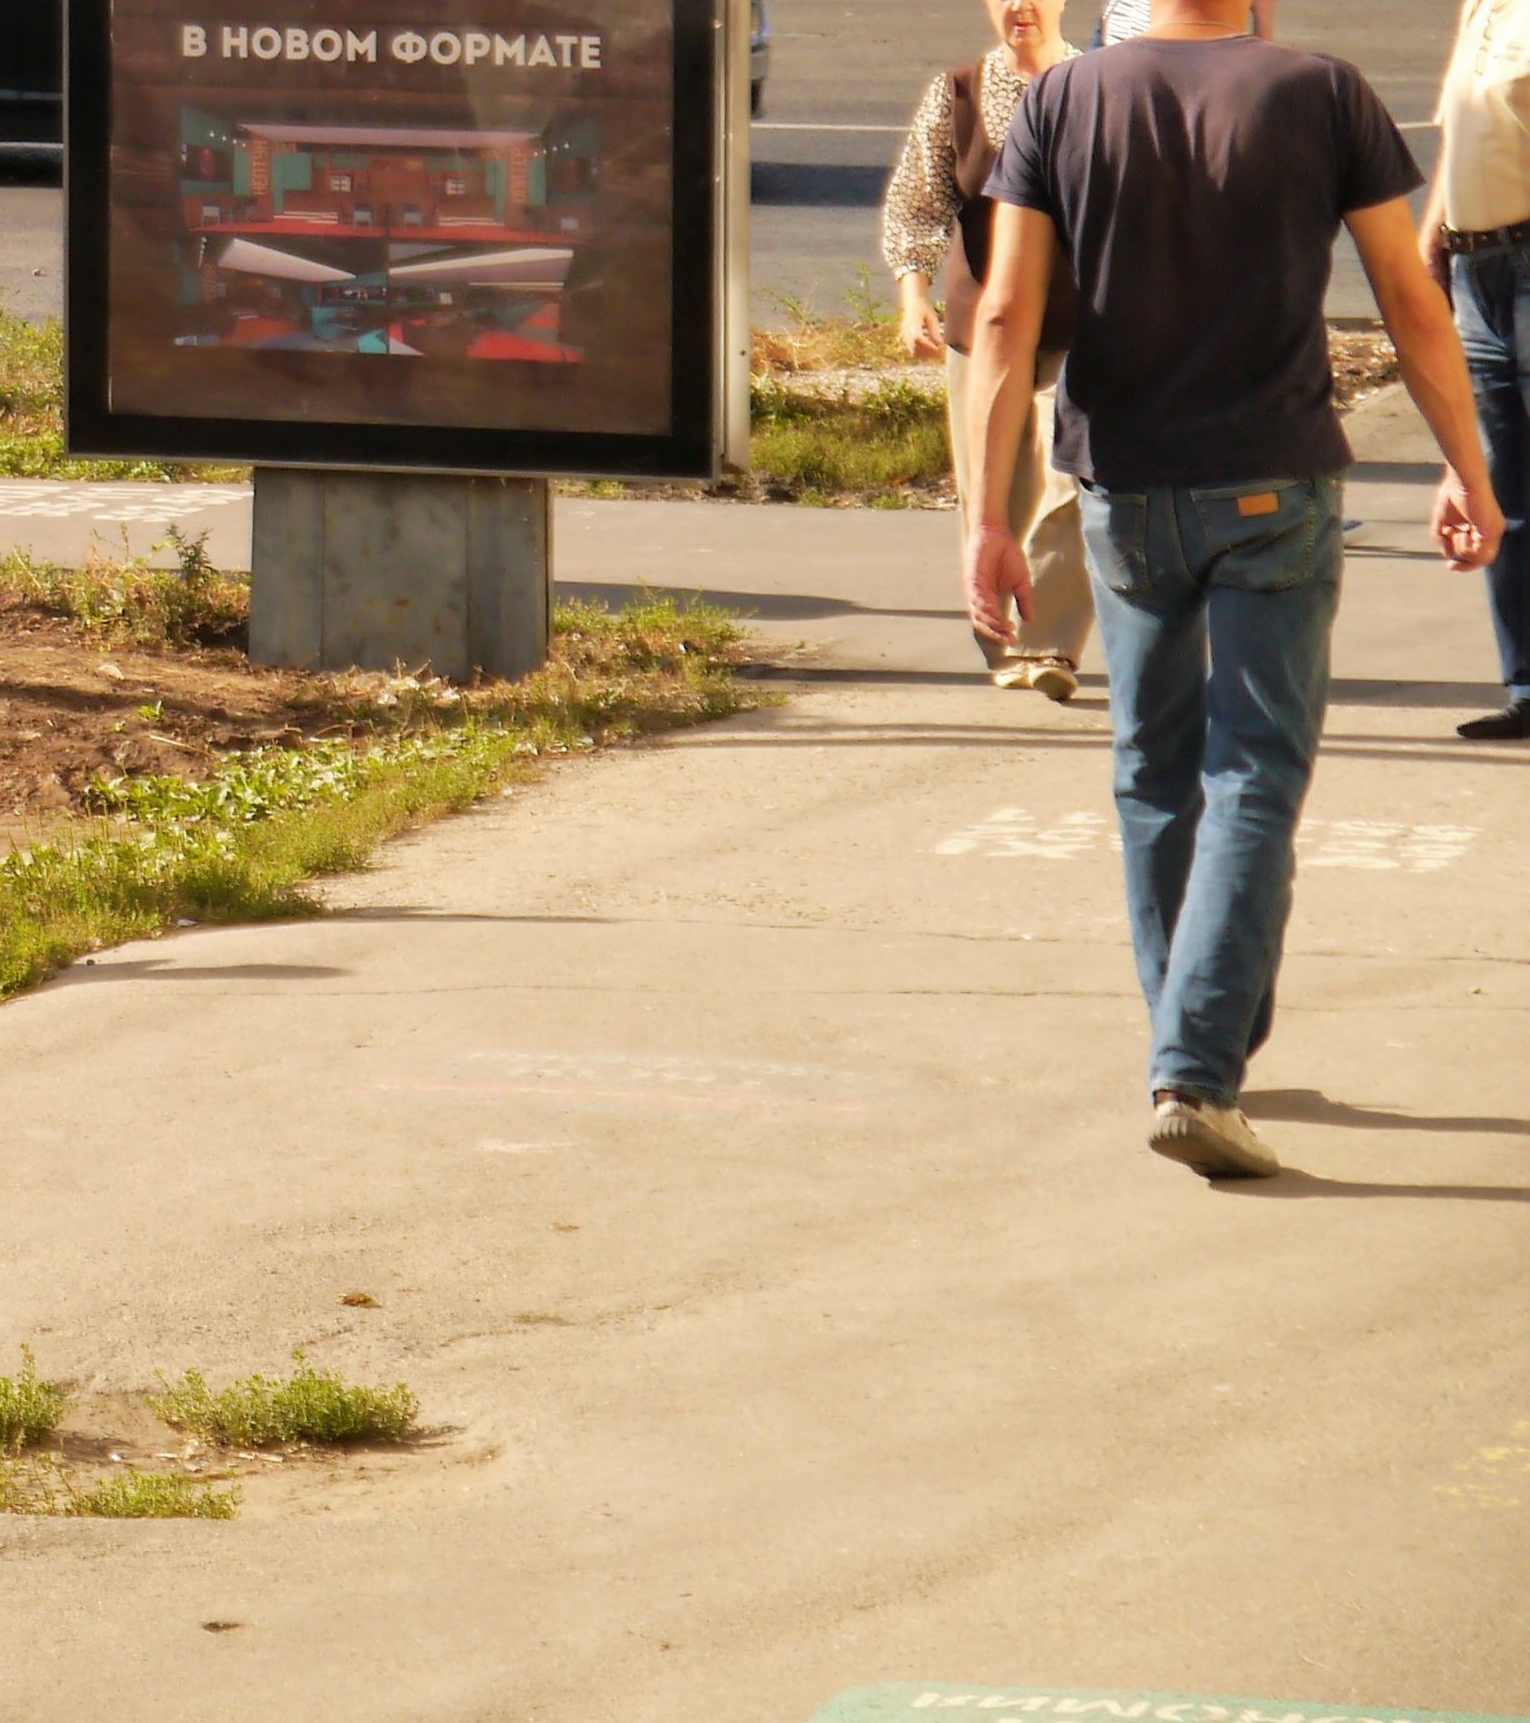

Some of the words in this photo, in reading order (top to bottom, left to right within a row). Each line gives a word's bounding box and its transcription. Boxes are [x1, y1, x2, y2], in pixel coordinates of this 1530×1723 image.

[182, 25, 207, 57] В
[222, 26, 377, 62] НОВОМ
[391, 30, 602, 70] ФОРМАТЕ
